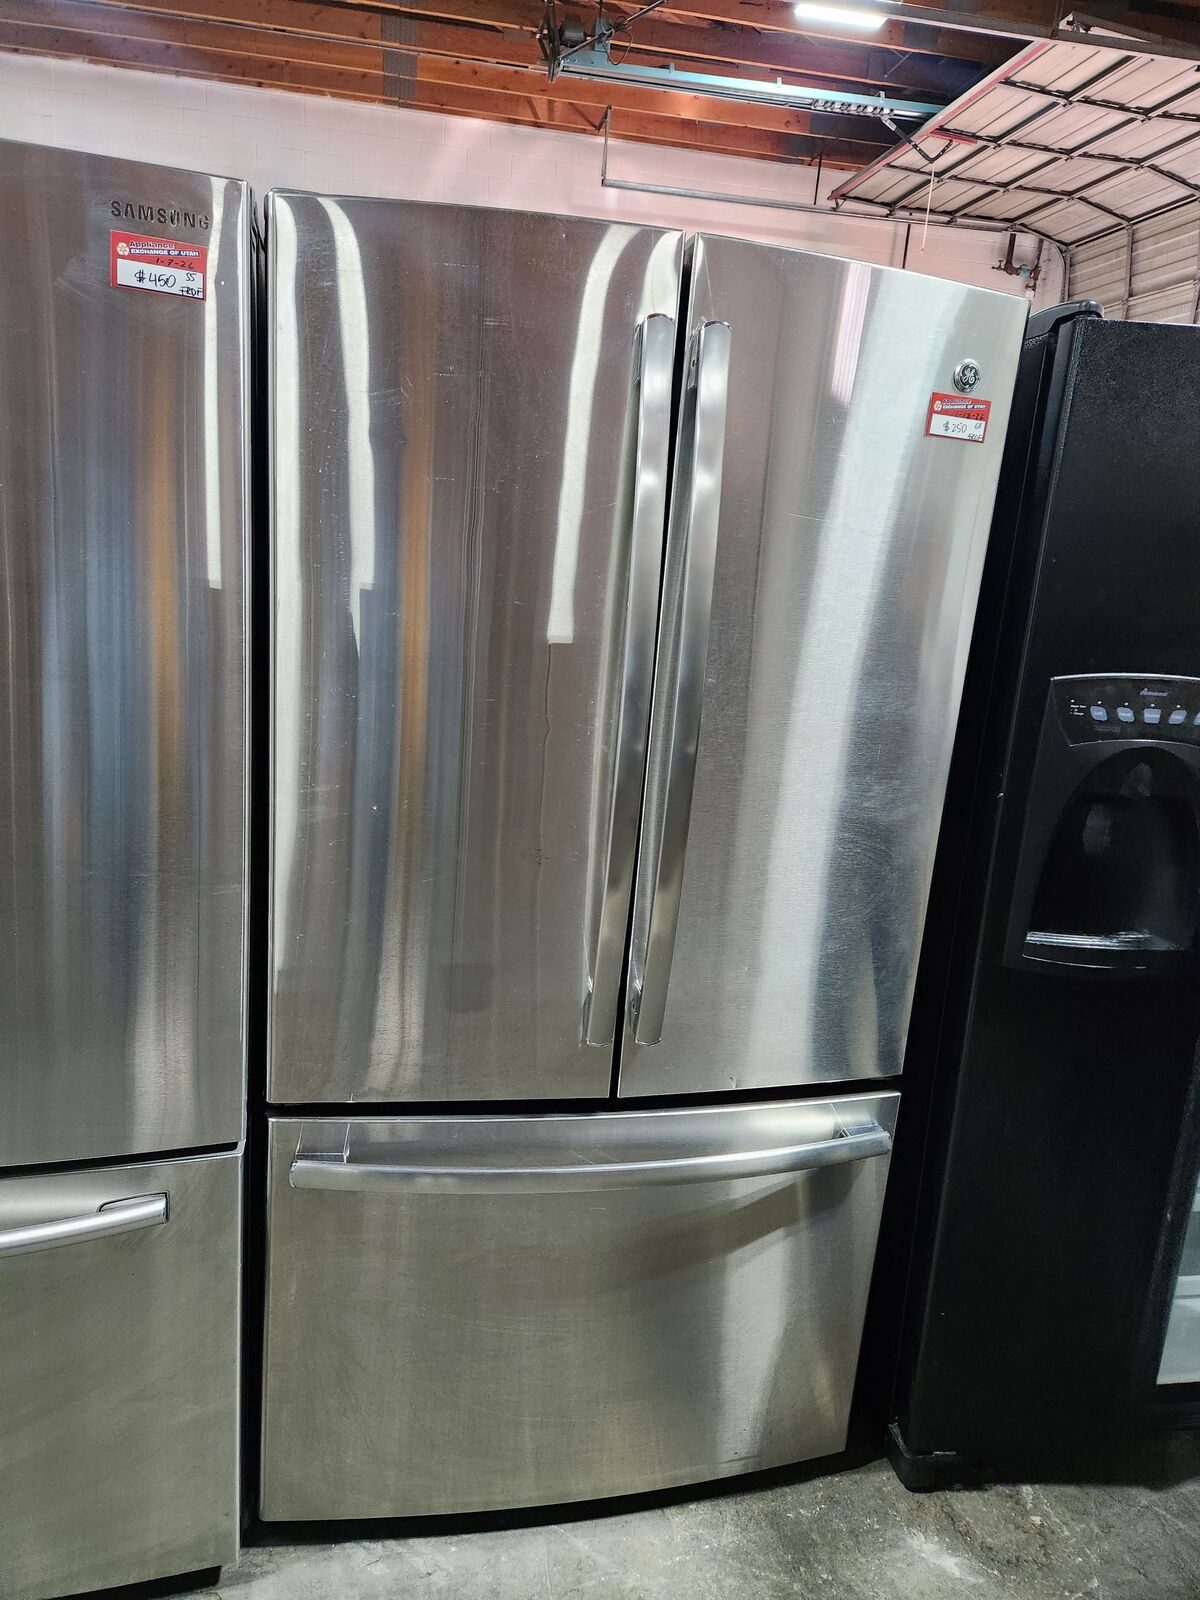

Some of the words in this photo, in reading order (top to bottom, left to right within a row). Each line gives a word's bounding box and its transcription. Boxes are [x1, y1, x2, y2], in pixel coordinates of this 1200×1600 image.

[111, 200, 209, 230] SAMSUNG
[129, 241, 175, 249] Appliance
[134, 269, 176, 288] $450
[943, 420, 968, 433] $250
